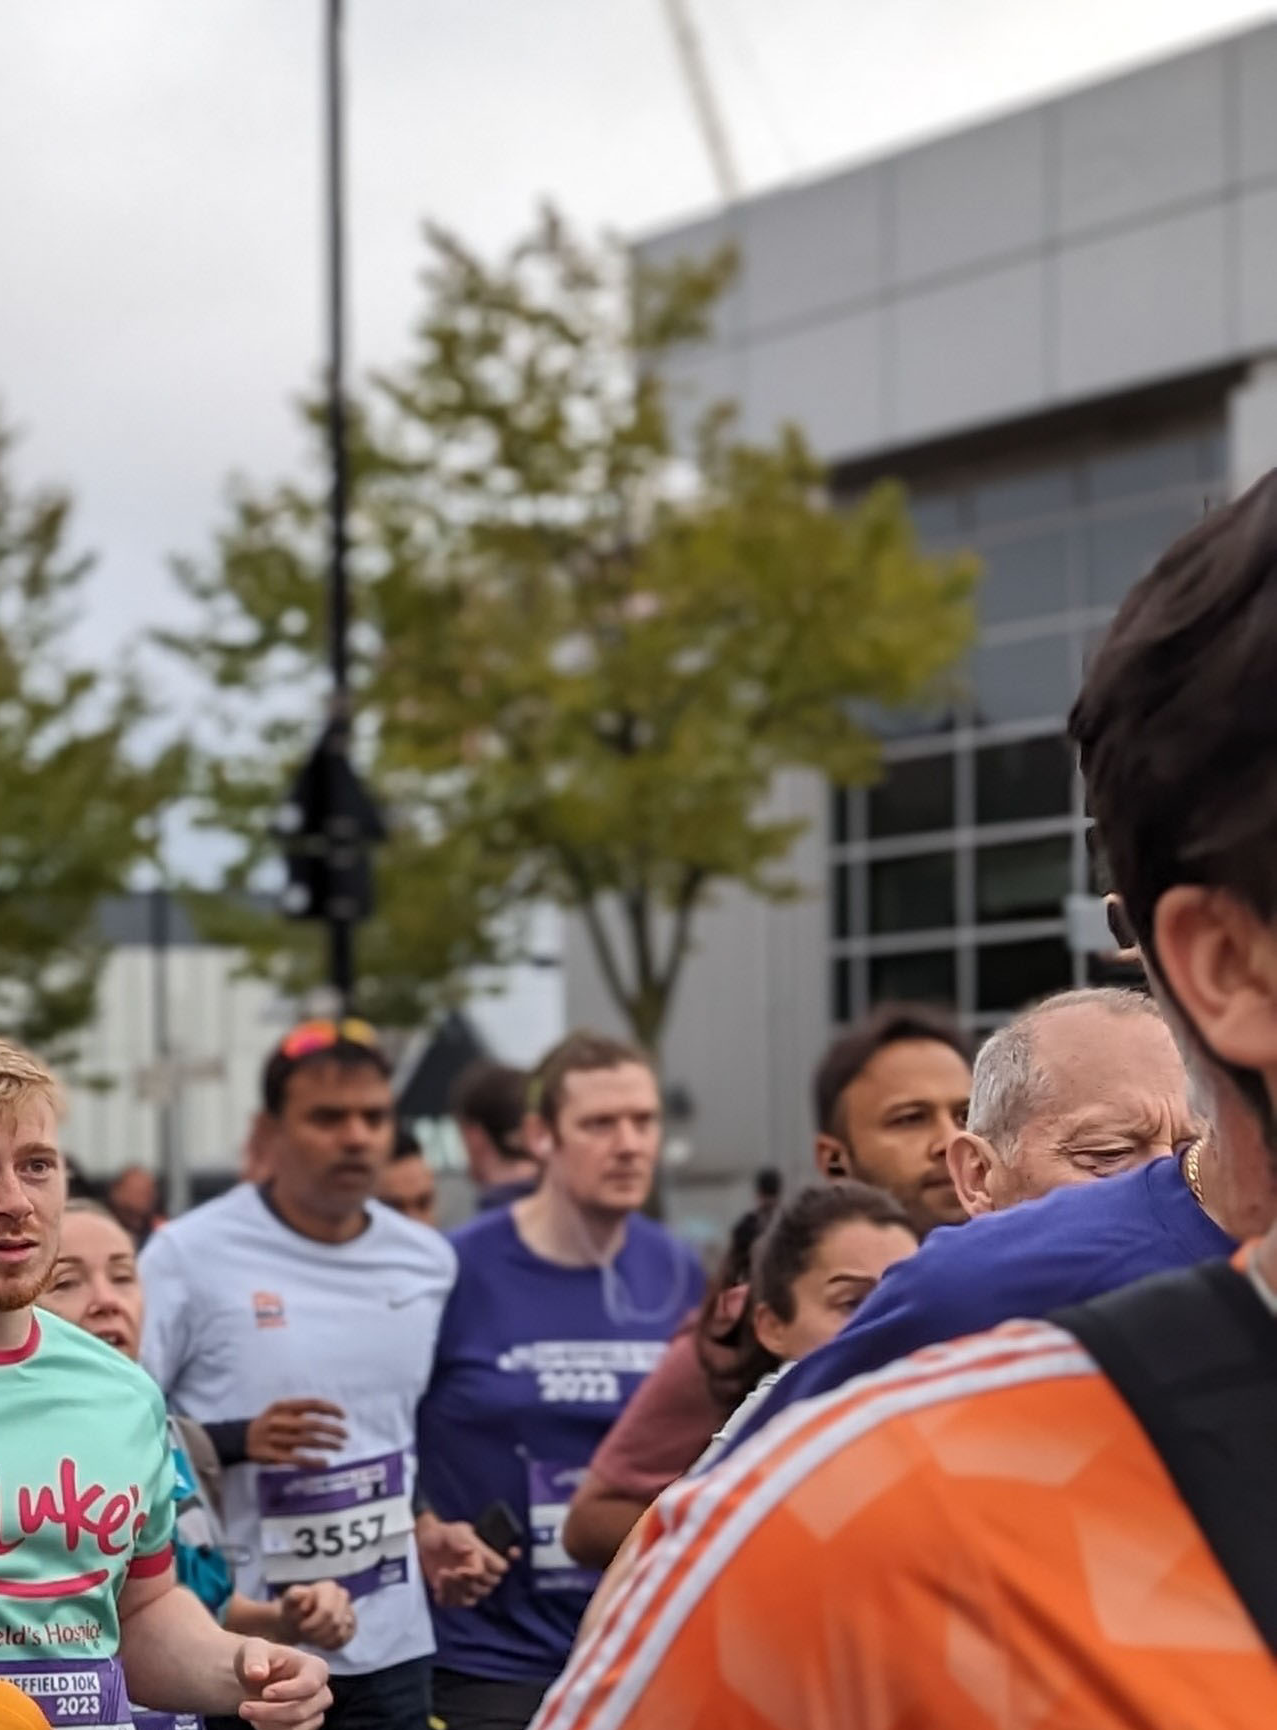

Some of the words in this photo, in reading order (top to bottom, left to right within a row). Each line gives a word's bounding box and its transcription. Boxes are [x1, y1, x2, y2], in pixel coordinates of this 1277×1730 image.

[295, 1513, 385, 1559] 3557
[1, 1676, 69, 1693] EFFIELD
[71, 1675, 98, 1692] 10K
[57, 1695, 100, 1716] 2023
